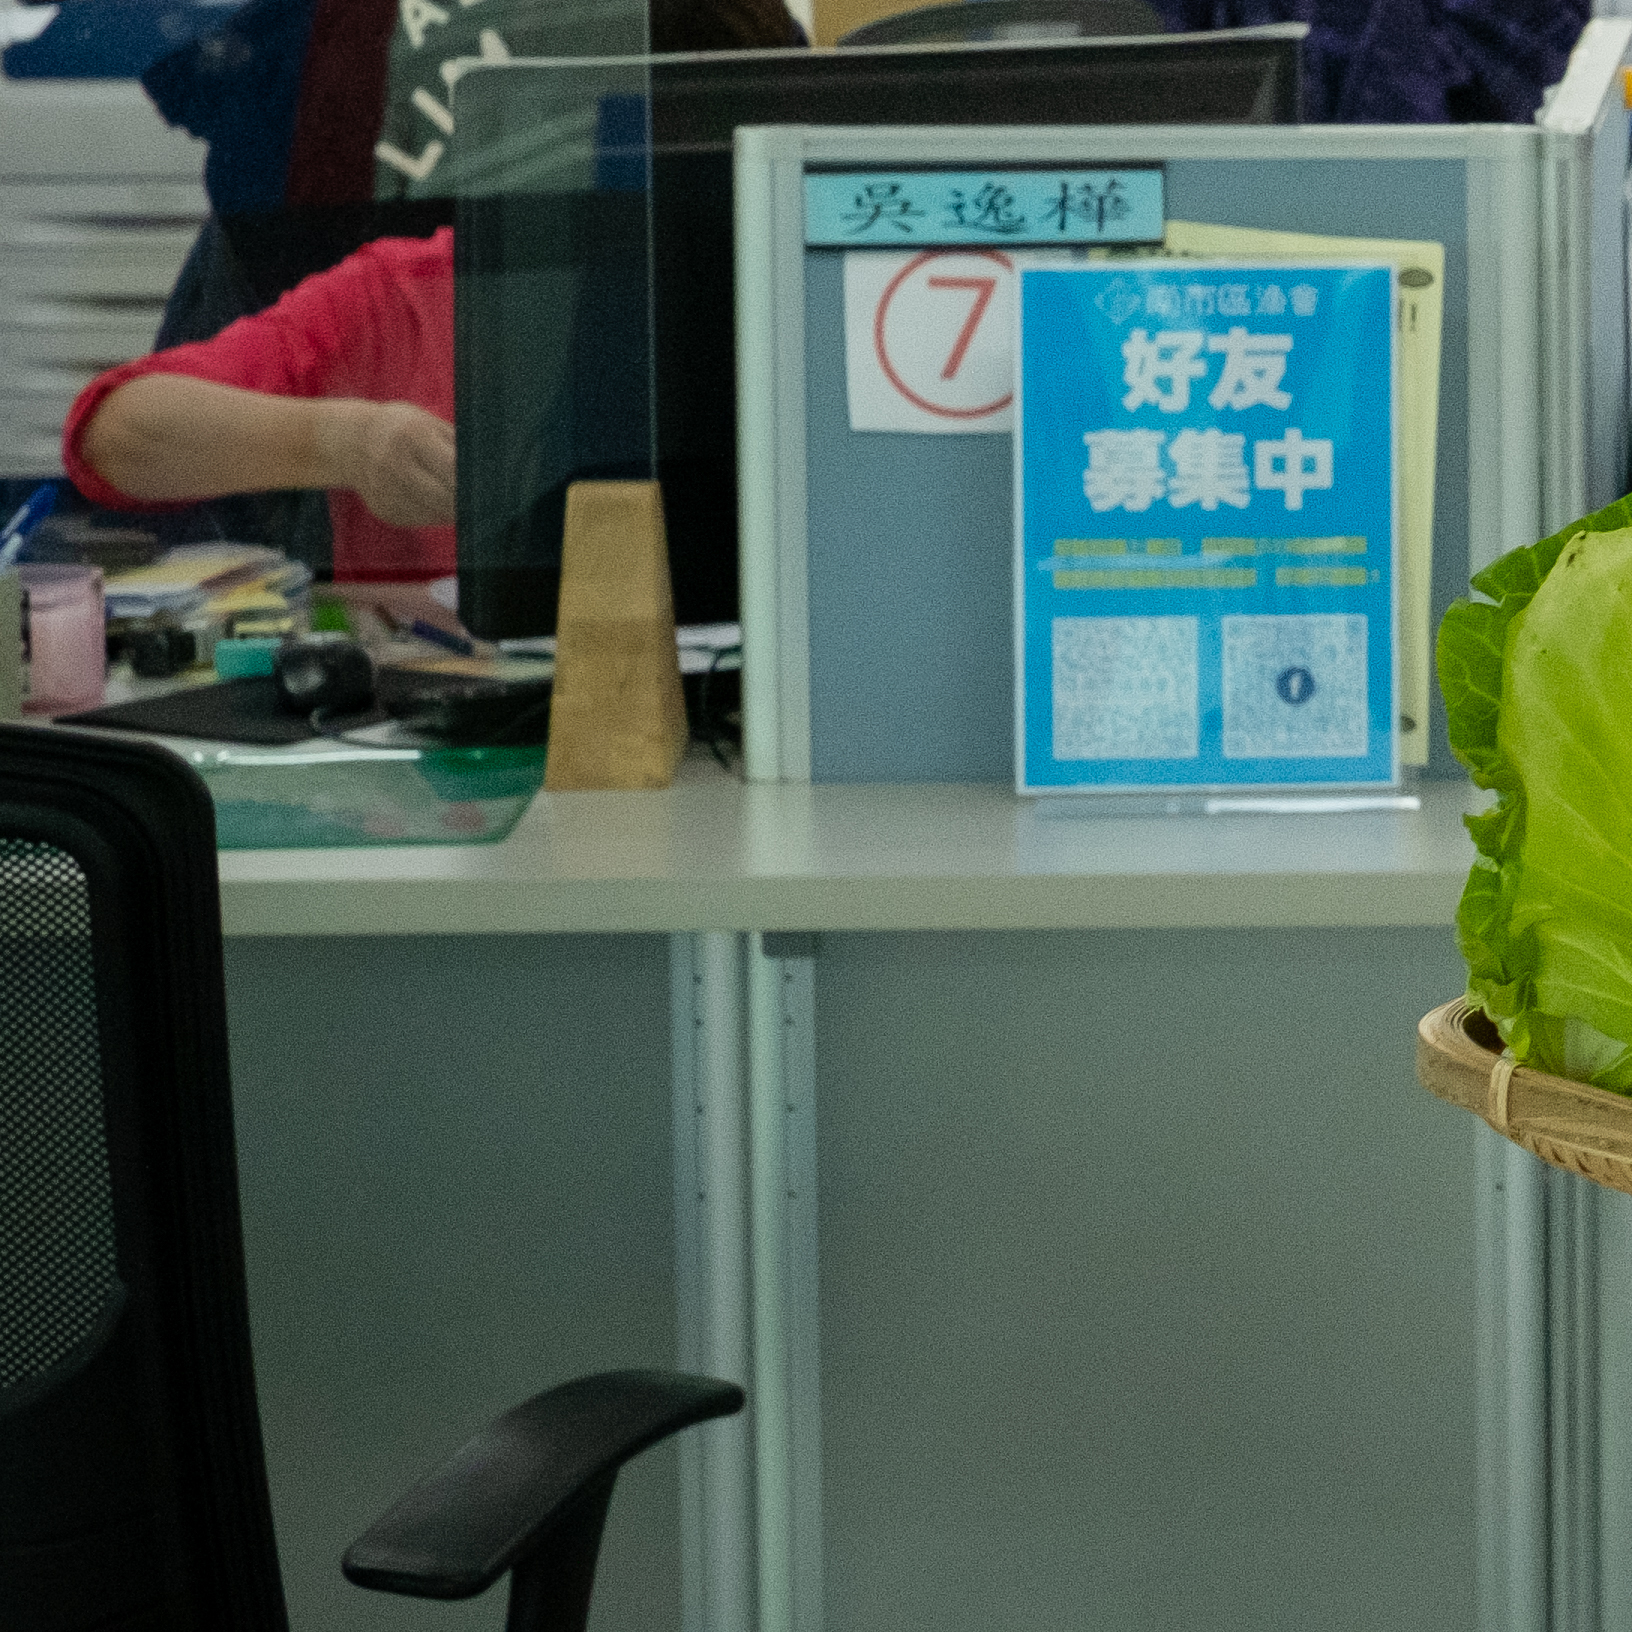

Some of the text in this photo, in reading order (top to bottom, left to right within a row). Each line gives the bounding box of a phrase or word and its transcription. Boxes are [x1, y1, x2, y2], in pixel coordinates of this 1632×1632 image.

[927, 275, 998, 381] 7
[1120, 325, 1296, 415] 好友
[1080, 426, 1336, 514] 募集中
